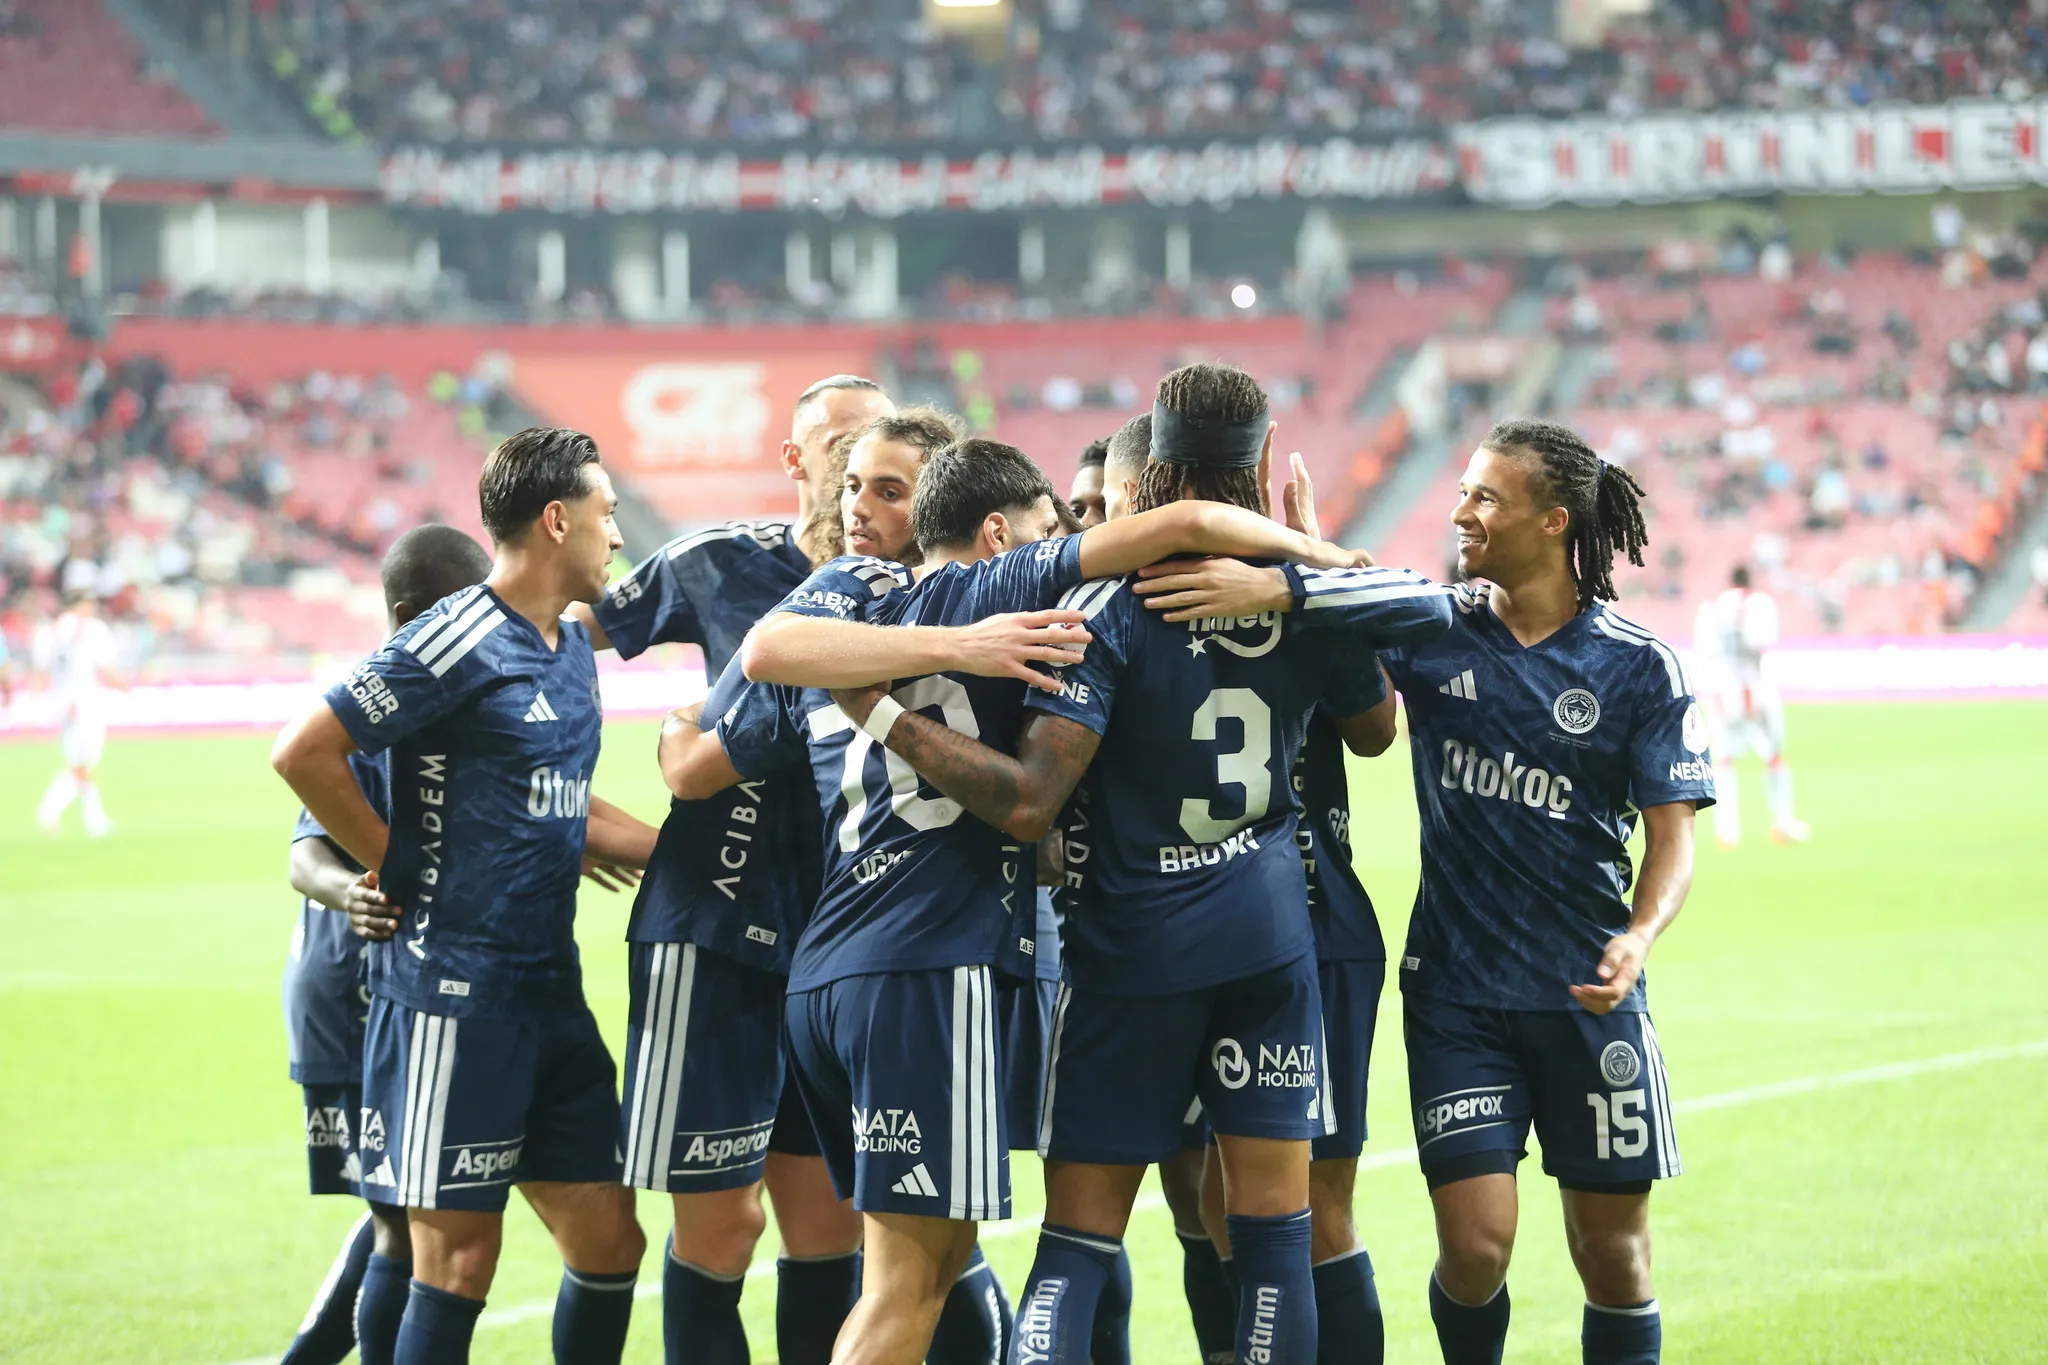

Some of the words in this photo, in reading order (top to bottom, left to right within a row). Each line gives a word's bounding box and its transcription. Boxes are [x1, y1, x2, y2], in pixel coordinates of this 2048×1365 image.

[1179, 688, 1272, 843] 3
[1160, 828, 1260, 873] BROWN
[1257, 1072, 1316, 1088] HOLDING
[1258, 1043, 1315, 1072] NATA
[1417, 1095, 1503, 1134] Asperox
[1587, 1089, 1648, 1159] 15
[1244, 1286, 1279, 1365] atırım
